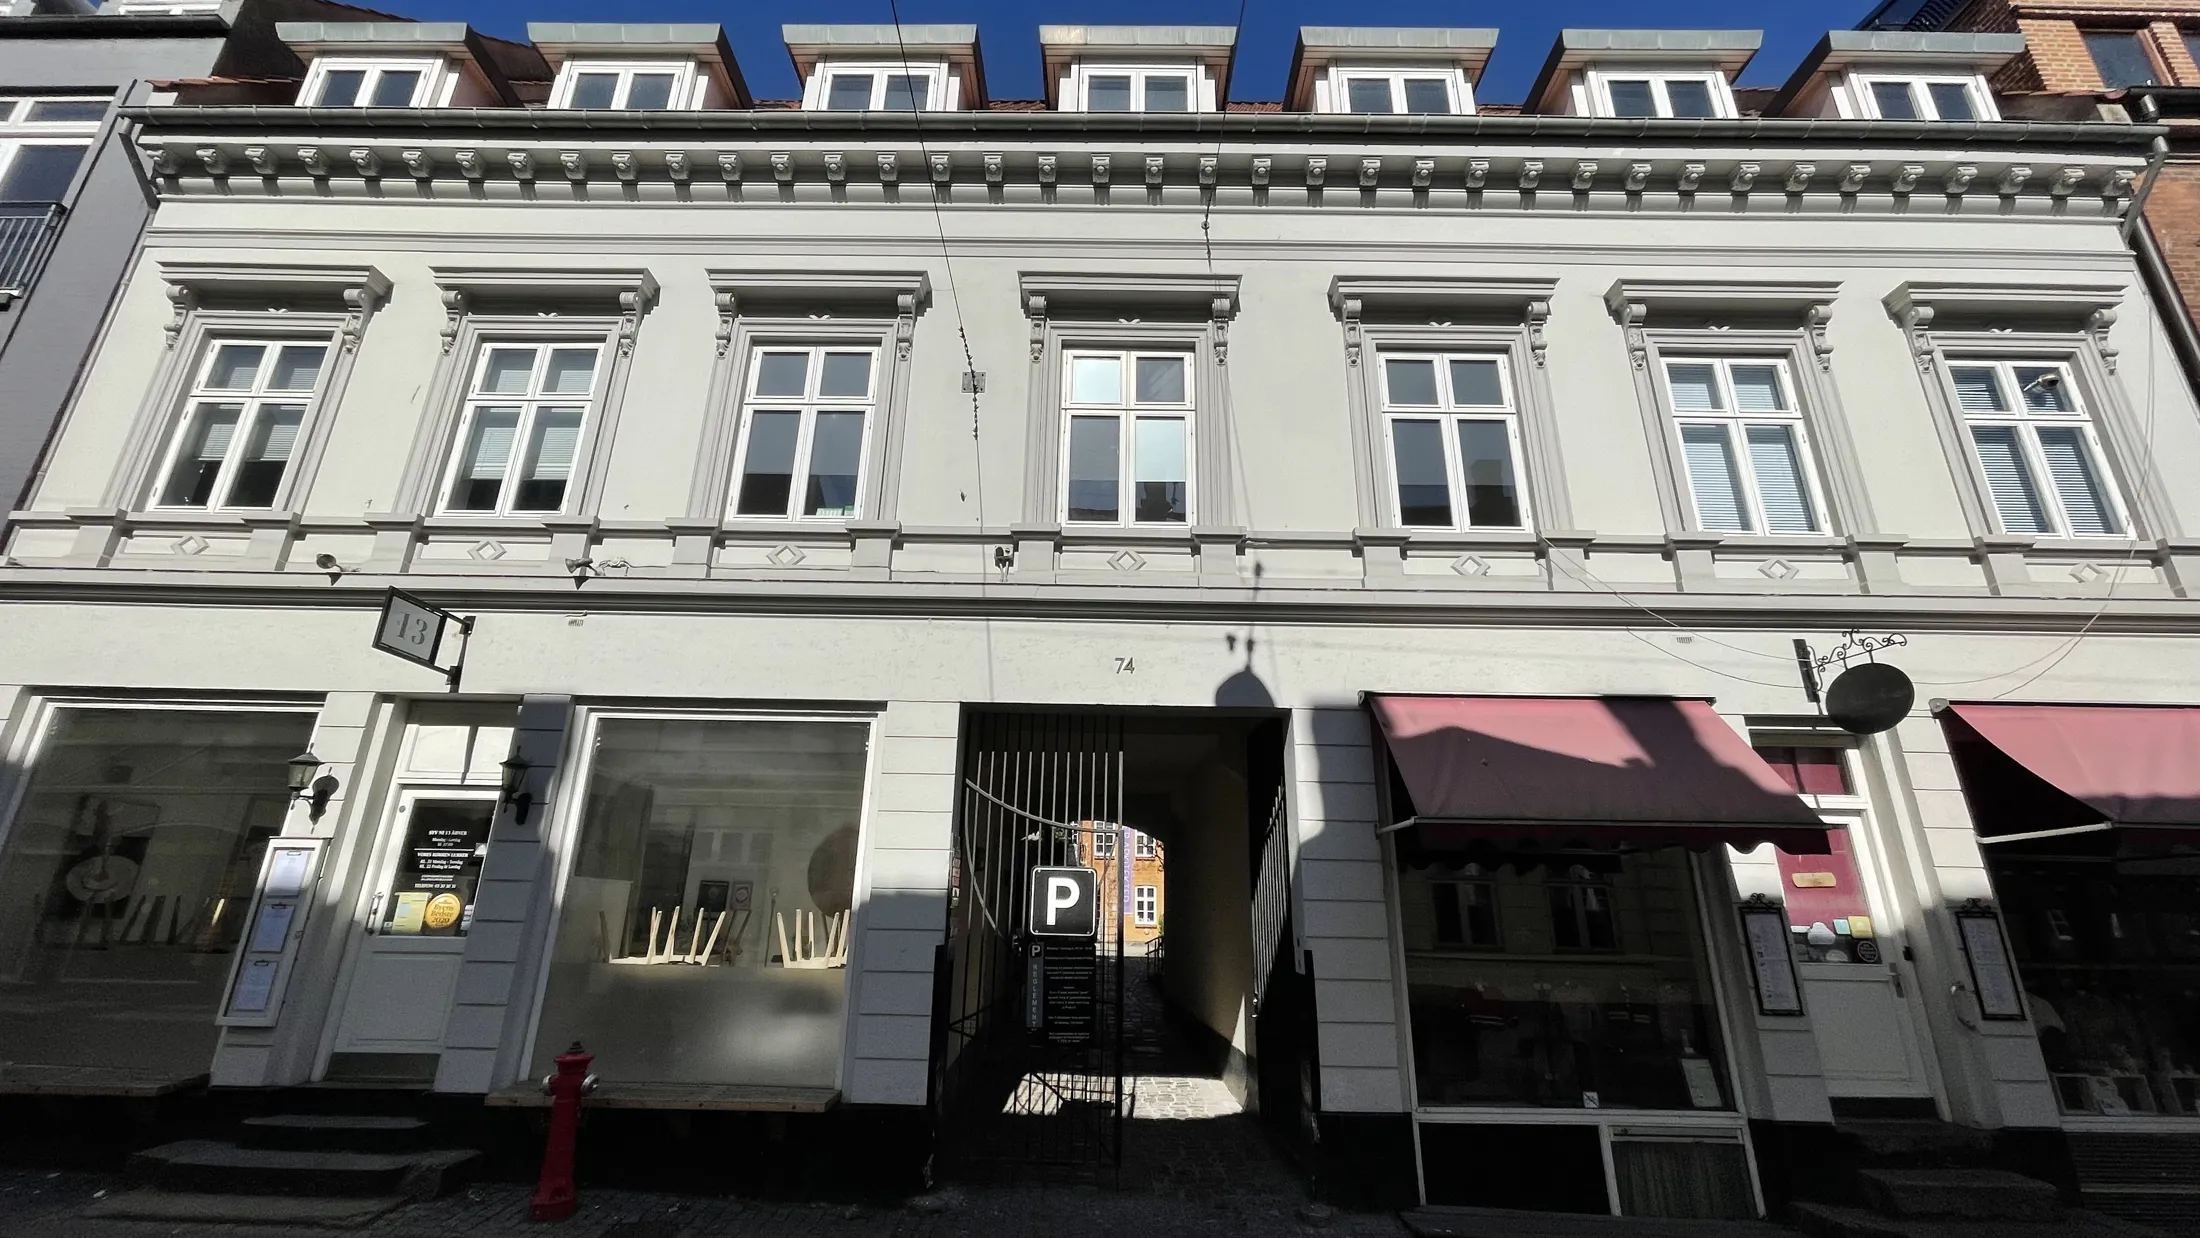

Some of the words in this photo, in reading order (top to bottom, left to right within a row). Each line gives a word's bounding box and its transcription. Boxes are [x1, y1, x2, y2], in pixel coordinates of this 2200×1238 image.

[397, 612, 429, 645] 13
[1115, 657, 1135, 674] 74
[1046, 877, 1080, 926] P
[1032, 945, 1040, 956] P
